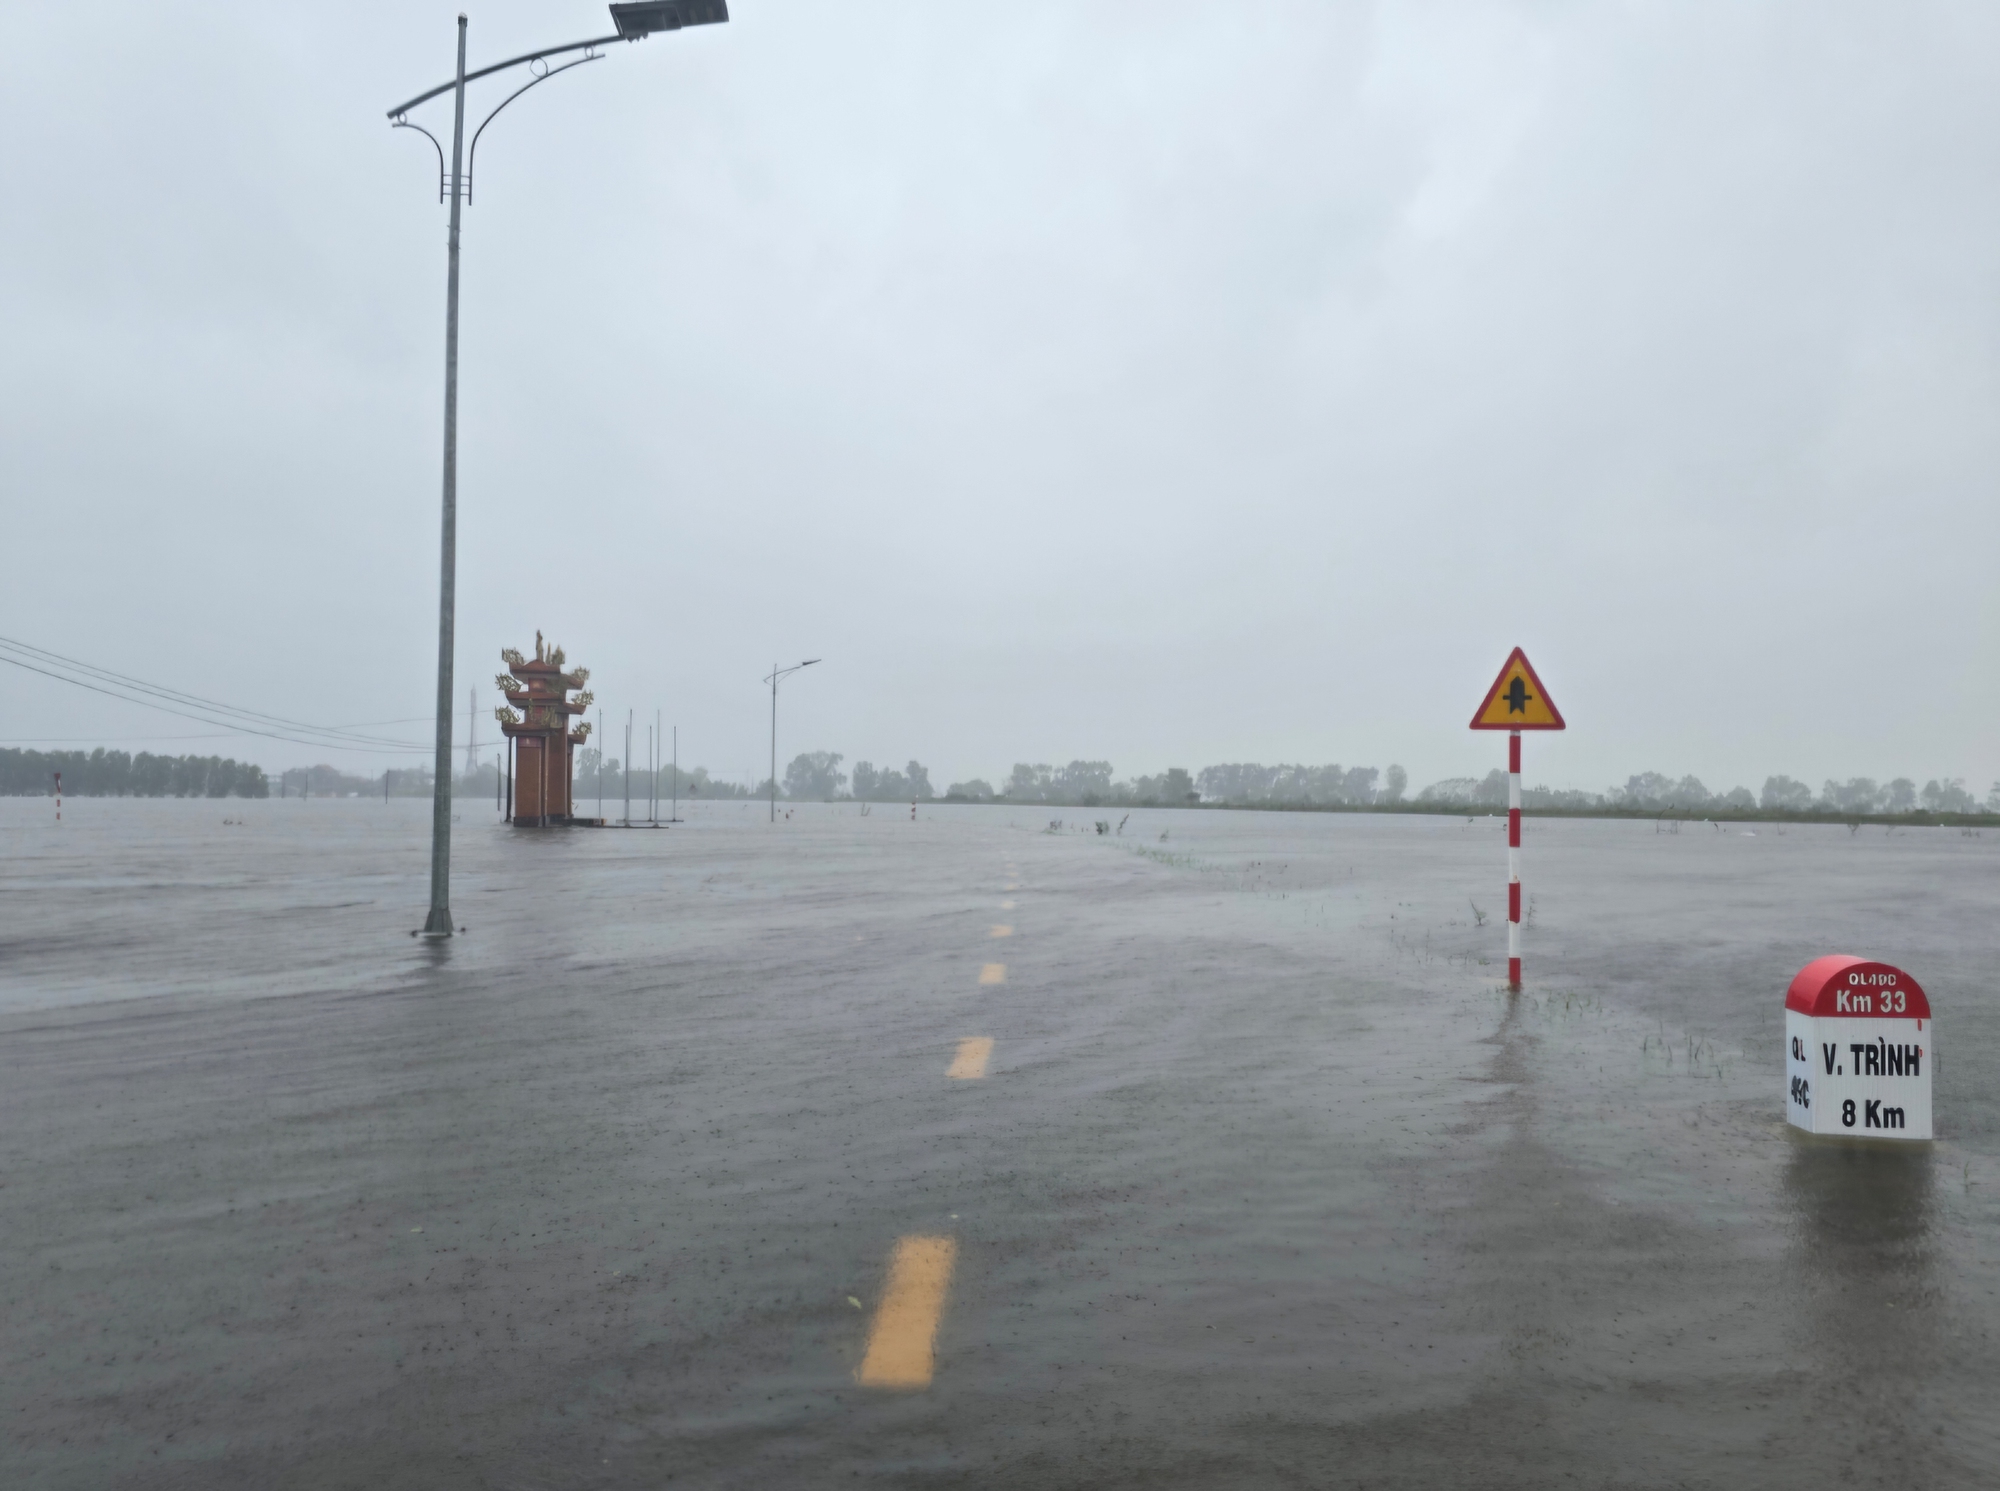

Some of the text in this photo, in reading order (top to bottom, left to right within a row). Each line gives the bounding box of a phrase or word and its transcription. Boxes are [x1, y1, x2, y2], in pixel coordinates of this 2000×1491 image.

[1836, 989, 1907, 1014] Km 33
[1822, 1036, 1920, 1077] V. TRÌNH
[1841, 1098, 1905, 1129] 8 Km
